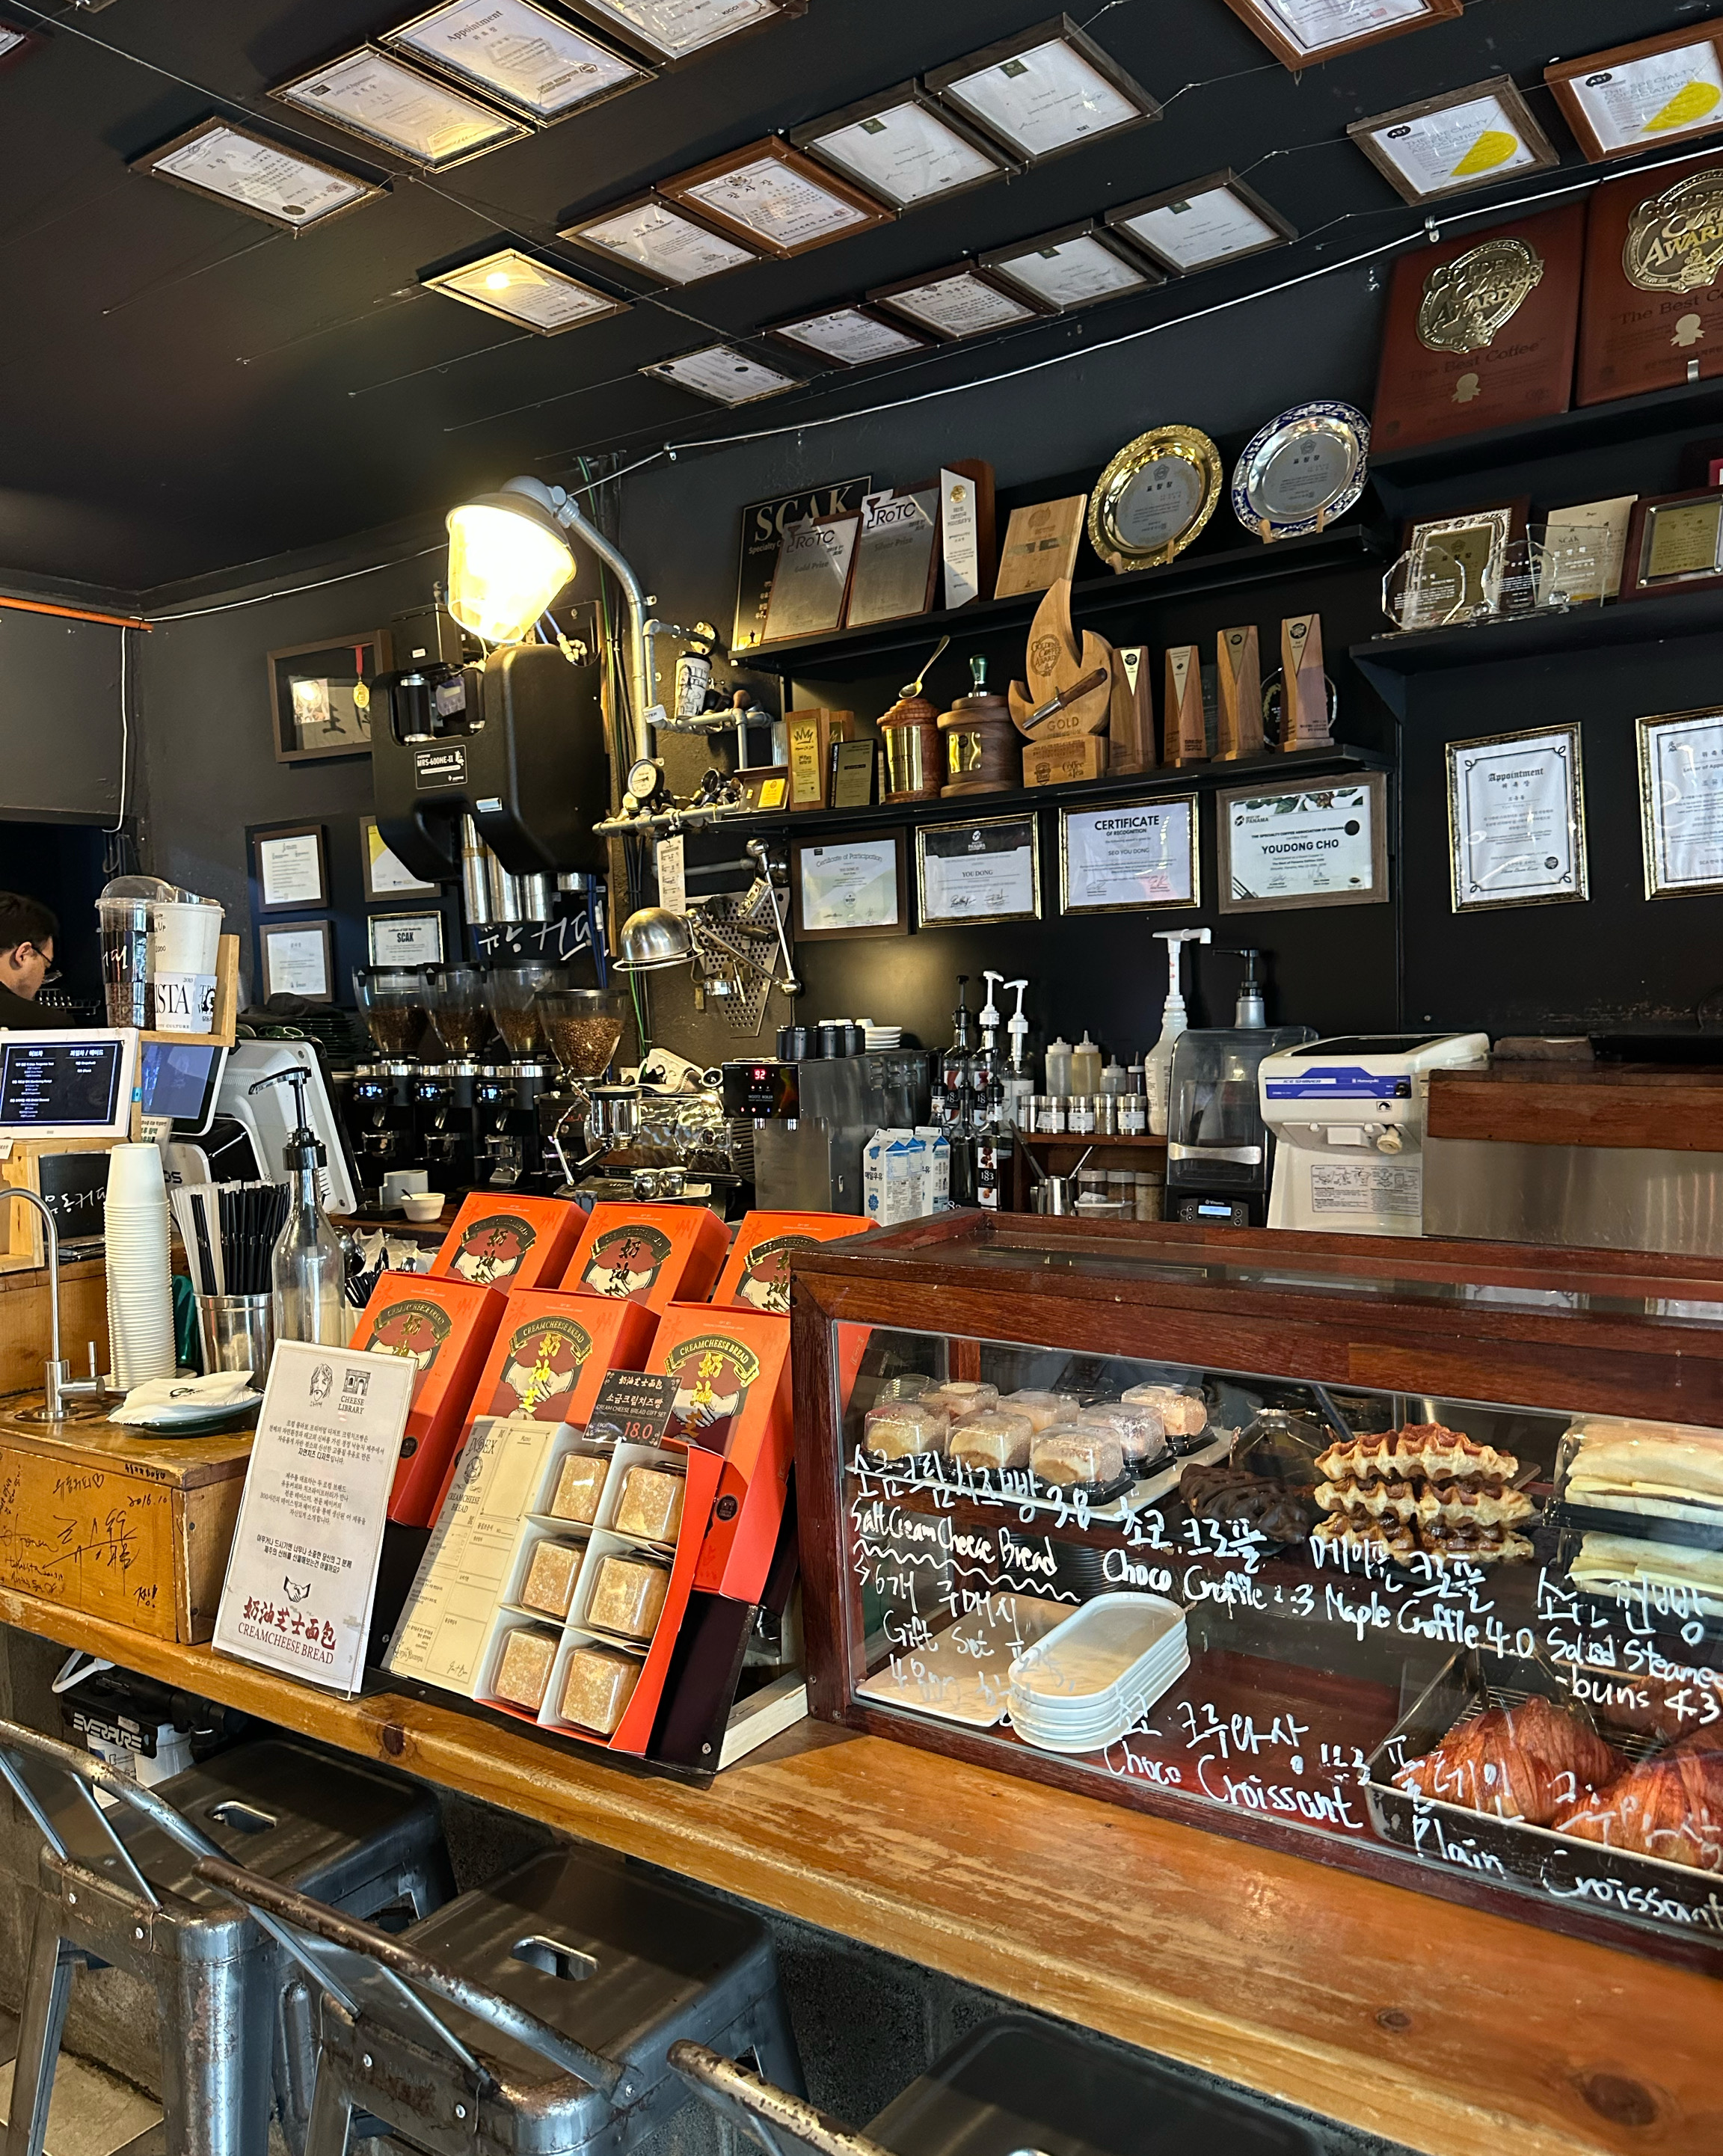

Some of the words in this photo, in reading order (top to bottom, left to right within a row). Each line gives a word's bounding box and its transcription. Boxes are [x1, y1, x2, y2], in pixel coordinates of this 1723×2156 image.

[446, 10, 503, 42] Appointment
[1659, 299, 1699, 316] Best
[1445, 355, 1481, 372] Best
[754, 485, 853, 543] SCAK
[748, 542, 775, 556] Specialty
[812, 560, 830, 571] Prize
[1031, 639, 1061, 652] GOLDEN
[1038, 646, 1063, 658] COFFEE
[1034, 654, 1057, 667] AWARD
[1047, 716, 1080, 732] GOLD
[1061, 761, 1085, 773] Coffee
[1487, 767, 1545, 784] Appointment
[1094, 814, 1160, 831] CERTIFICATE
[1114, 828, 1147, 836] RECOGNITION
[1262, 841, 1313, 855] YOUDONG
[1316, 839, 1339, 850] CHO
[816, 856, 843, 867] Certificate
[849, 853, 883, 862] Participation
[974, 869, 994, 877] DONG
[396, 932, 414, 943] SCAK
[754, 1069, 767, 1080] 92
[864, 1171, 884, 1182] 매일우유
[522, 1318, 571, 1337] CREAMCHEESE
[568, 1323, 586, 1344] BREAD
[679, 1338, 734, 1357] CREAMCHEESE
[731, 1341, 751, 1366] BREAD
[618, 1375, 663, 1390] 奶油芝士面包
[337, 1403, 365, 1415] LIBRARY
[340, 1395, 365, 1407] CHEESE
[606, 1392, 663, 1410] 소금크림치즈빵
[612, 1406, 630, 1414] CHEESE
[295, 1422, 309, 1430] 콜라보
[309, 1425, 328, 1434] 프리미엄
[328, 1428, 341, 1437] 디저트
[342, 1431, 369, 1443] 크림치즈빵은
[624, 1421, 654, 1440] 18.0
[282, 1427, 304, 1438] 자연환경과
[304, 1431, 317, 1441] 태고의
[317, 1434, 331, 1444] 신비를
[331, 1437, 341, 1446] 가진
[365, 1444, 385, 1455] 제주에서
[295, 1439, 304, 1447] 자란
[318, 1443, 331, 1454] 신선한
[332, 1446, 346, 1456] 고품질
[347, 1449, 360, 1459] 우유로
[361, 1453, 371, 1462] 만든
[464, 1435, 499, 1457] INDEX
[298, 1447, 316, 1458] 자연치즈
[316, 1452, 344, 1465] 디저트입니다.
[281, 1480, 303, 1490] 유동커피와
[303, 1485, 339, 1500] 치즈라이브러리가
[285, 1472, 298, 1481] 제주를
[299, 1475, 316, 1485] 대표하는
[322, 1481, 332, 1490] 로컬
[332, 1483, 346, 1493] 브랜드
[285, 1489, 294, 1497] 전문
[313, 1496, 323, 1505] 전문
[323, 1499, 342, 1510] 베이커의
[450, 1503, 469, 1514] BREAD
[1047, 1485, 1092, 1532] 3.8
[280, 1498, 303, 1508] 테이스팅과
[303, 1502, 321, 1512] 베이킹을
[322, 1507, 331, 1515] 통해
[331, 1509, 345, 1520] 생산된
[351, 1515, 366, 1526] 제품을
[289, 1508, 307, 1520] 자신있게
[307, 1513, 331, 1525] 소개합니다.
[850, 1497, 887, 1534] Salt
[888, 1505, 937, 1543] Cream
[937, 1515, 996, 1564] Cheese
[998, 1526, 1058, 1577] Bread
[257, 1534, 274, 1546] 아무거나
[274, 1539, 293, 1551] 드시기엔
[293, 1544, 307, 1555] 너무나
[307, 1549, 322, 1560] 소중한
[322, 1552, 336, 1564] 당신의
[264, 1545, 277, 1556] 제주의
[277, 1549, 292, 1560] 신비를
[292, 1553, 319, 1568] 선물해보는건
[319, 1561, 340, 1574] 어떨까요?
[1309, 1535, 1404, 1593] 메이플
[1102, 1548, 1173, 1592] Choco
[242, 1595, 338, 1651] 奶油芝士面包
[1324, 1582, 1391, 1641] Maple
[1396, 1599, 1480, 1650] Croffle
[1484, 1615, 1535, 1659] 4.0
[238, 1621, 301, 1655] CREAMCHEESE
[301, 1643, 334, 1665] BREAD
[882, 1609, 939, 1653] Gift
[950, 1627, 995, 1659] Set
[1663, 1689, 1720, 1725] 4.3
[73, 1712, 144, 1755] EVERPURE
[1103, 1738, 1182, 1785] Choco
[1197, 1754, 1364, 1829] Croissant
[1412, 1813, 1508, 1881] Plain
